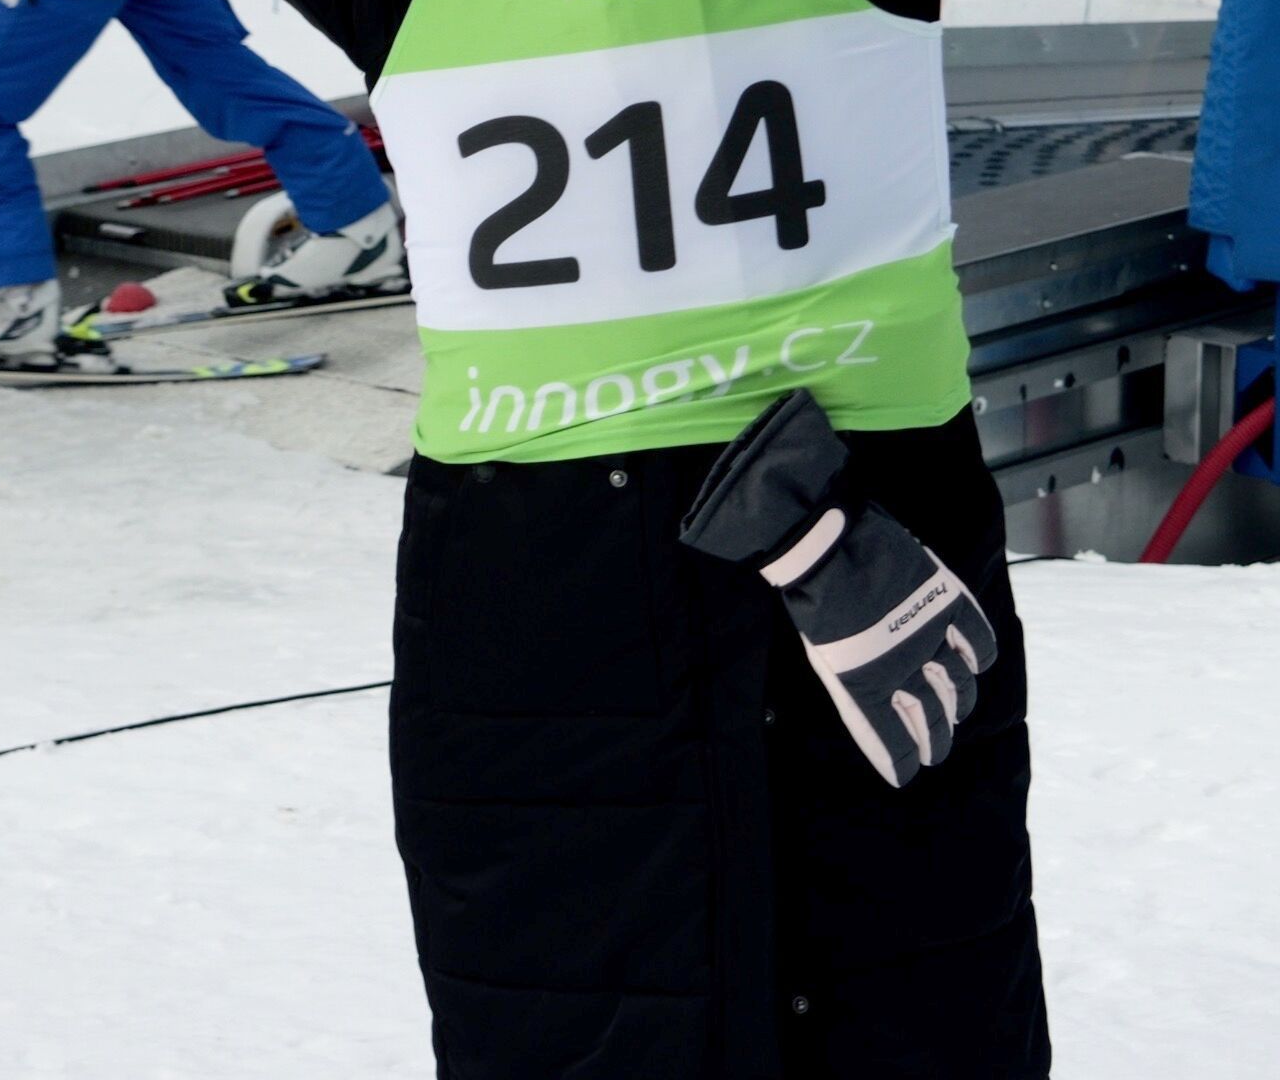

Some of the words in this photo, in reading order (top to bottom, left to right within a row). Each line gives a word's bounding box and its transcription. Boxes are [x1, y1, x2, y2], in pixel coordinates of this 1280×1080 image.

[457, 80, 826, 291] 214
[458, 319, 879, 434] innogy.cz
[888, 581, 948, 633] hannah
